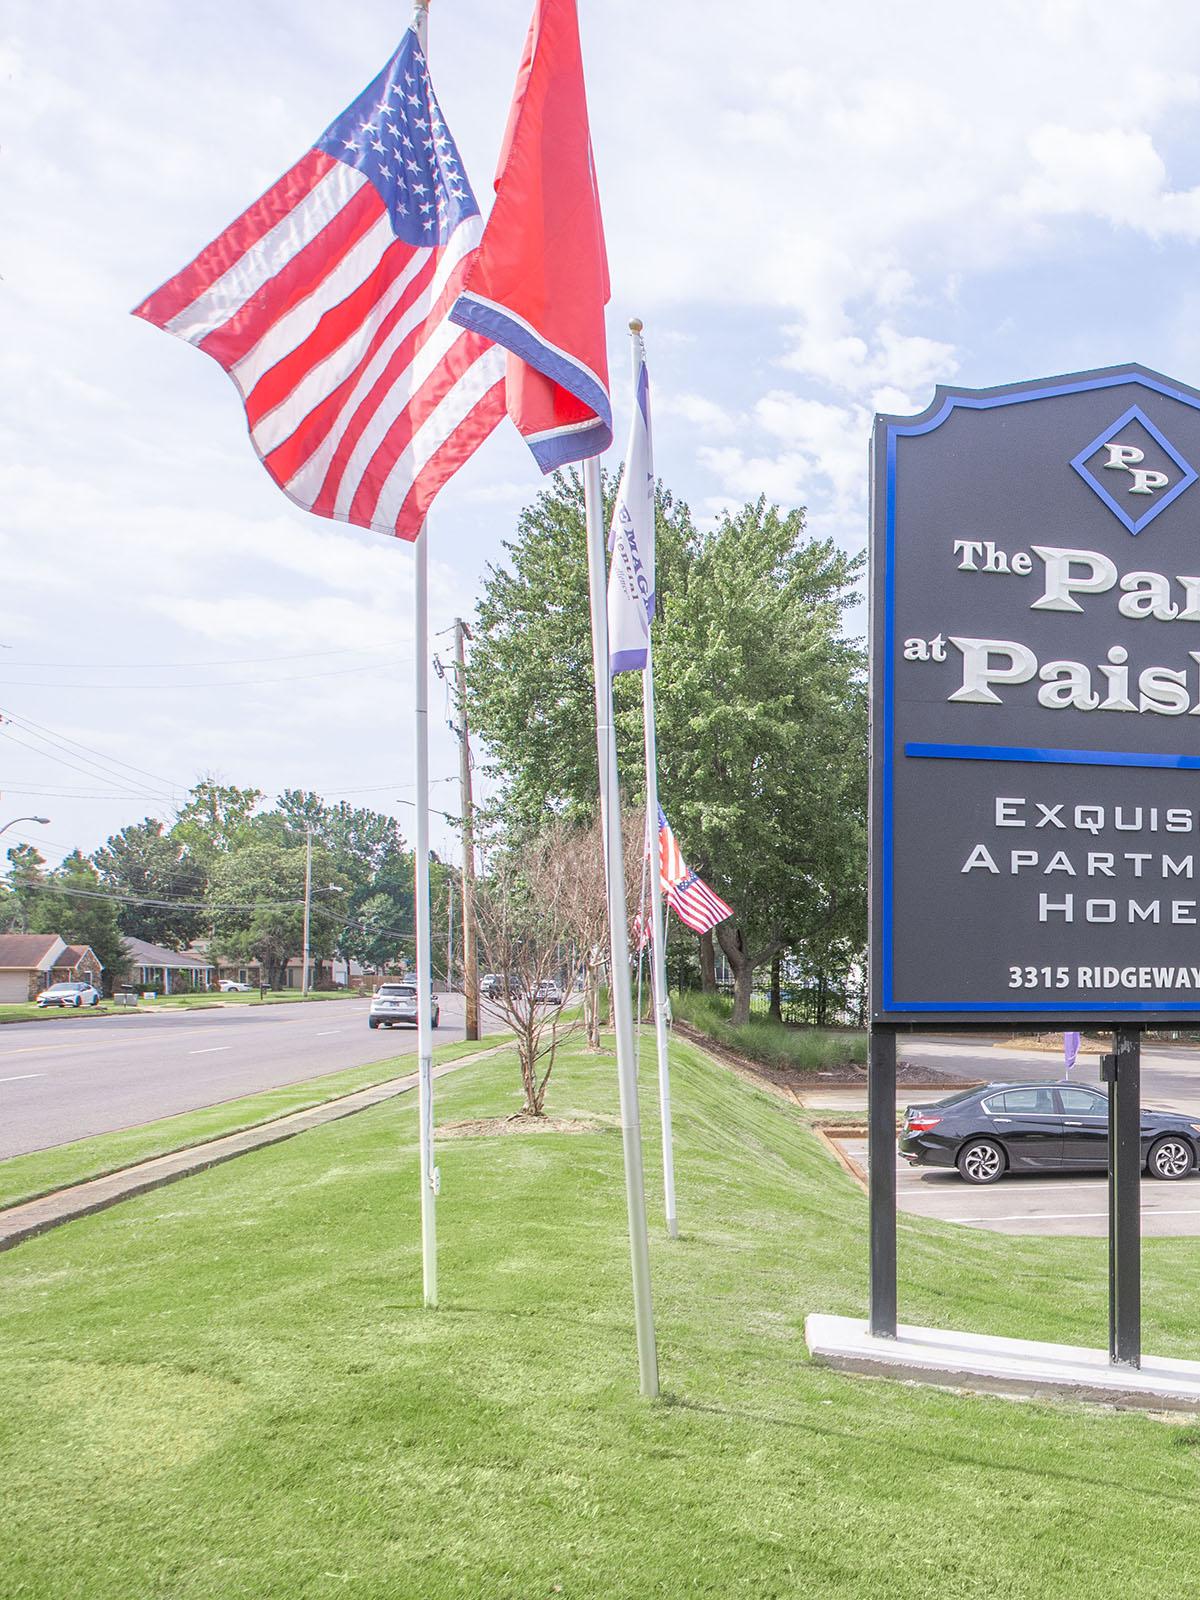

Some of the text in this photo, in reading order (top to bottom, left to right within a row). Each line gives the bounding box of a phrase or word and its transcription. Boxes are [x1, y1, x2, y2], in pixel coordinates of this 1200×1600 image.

[953, 539, 1034, 576] The
[903, 632, 948, 662] at
[1008, 966, 1070, 989] 3315
